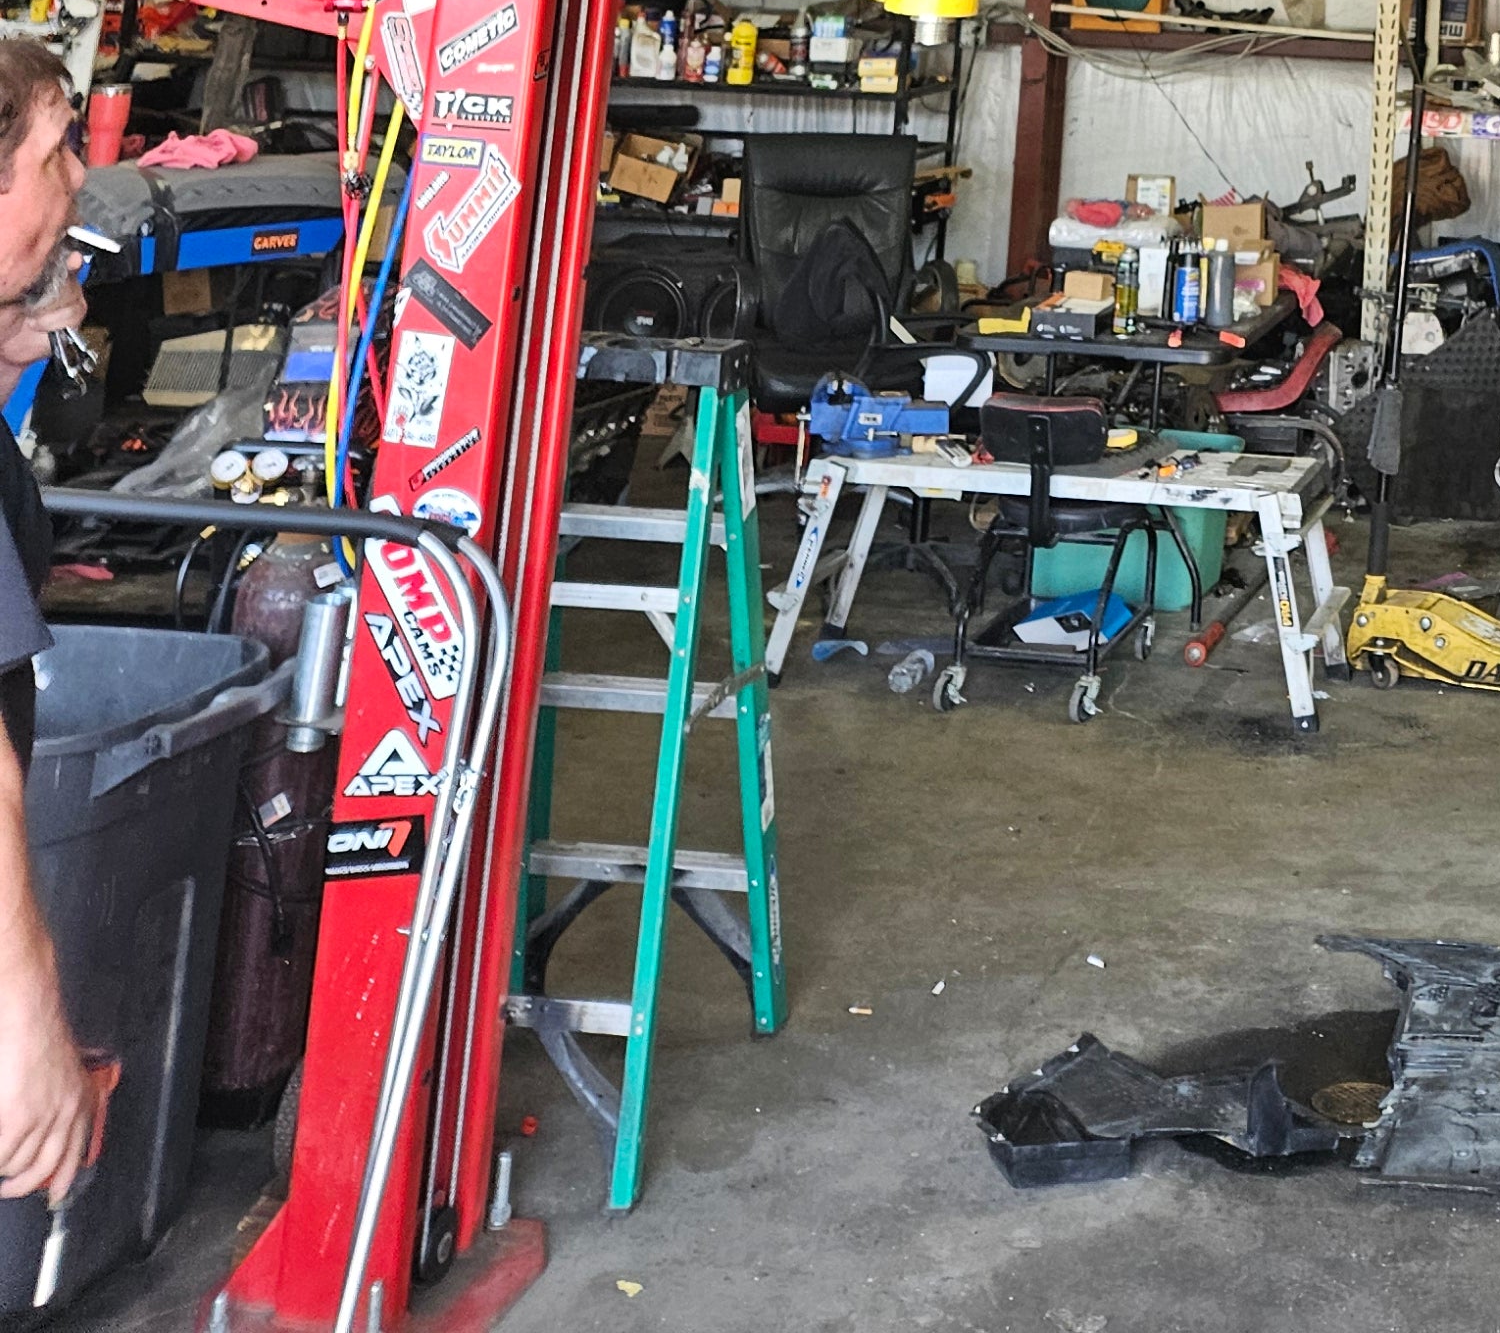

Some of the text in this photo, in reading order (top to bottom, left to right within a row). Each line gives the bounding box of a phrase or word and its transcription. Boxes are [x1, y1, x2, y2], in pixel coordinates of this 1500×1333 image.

[427, 144, 477, 159] TAYLOR
[403, 610, 443, 678] CAMS
[363, 611, 443, 747] APEX
[343, 774, 440, 797] APEX
[327, 827, 394, 854] ONI
